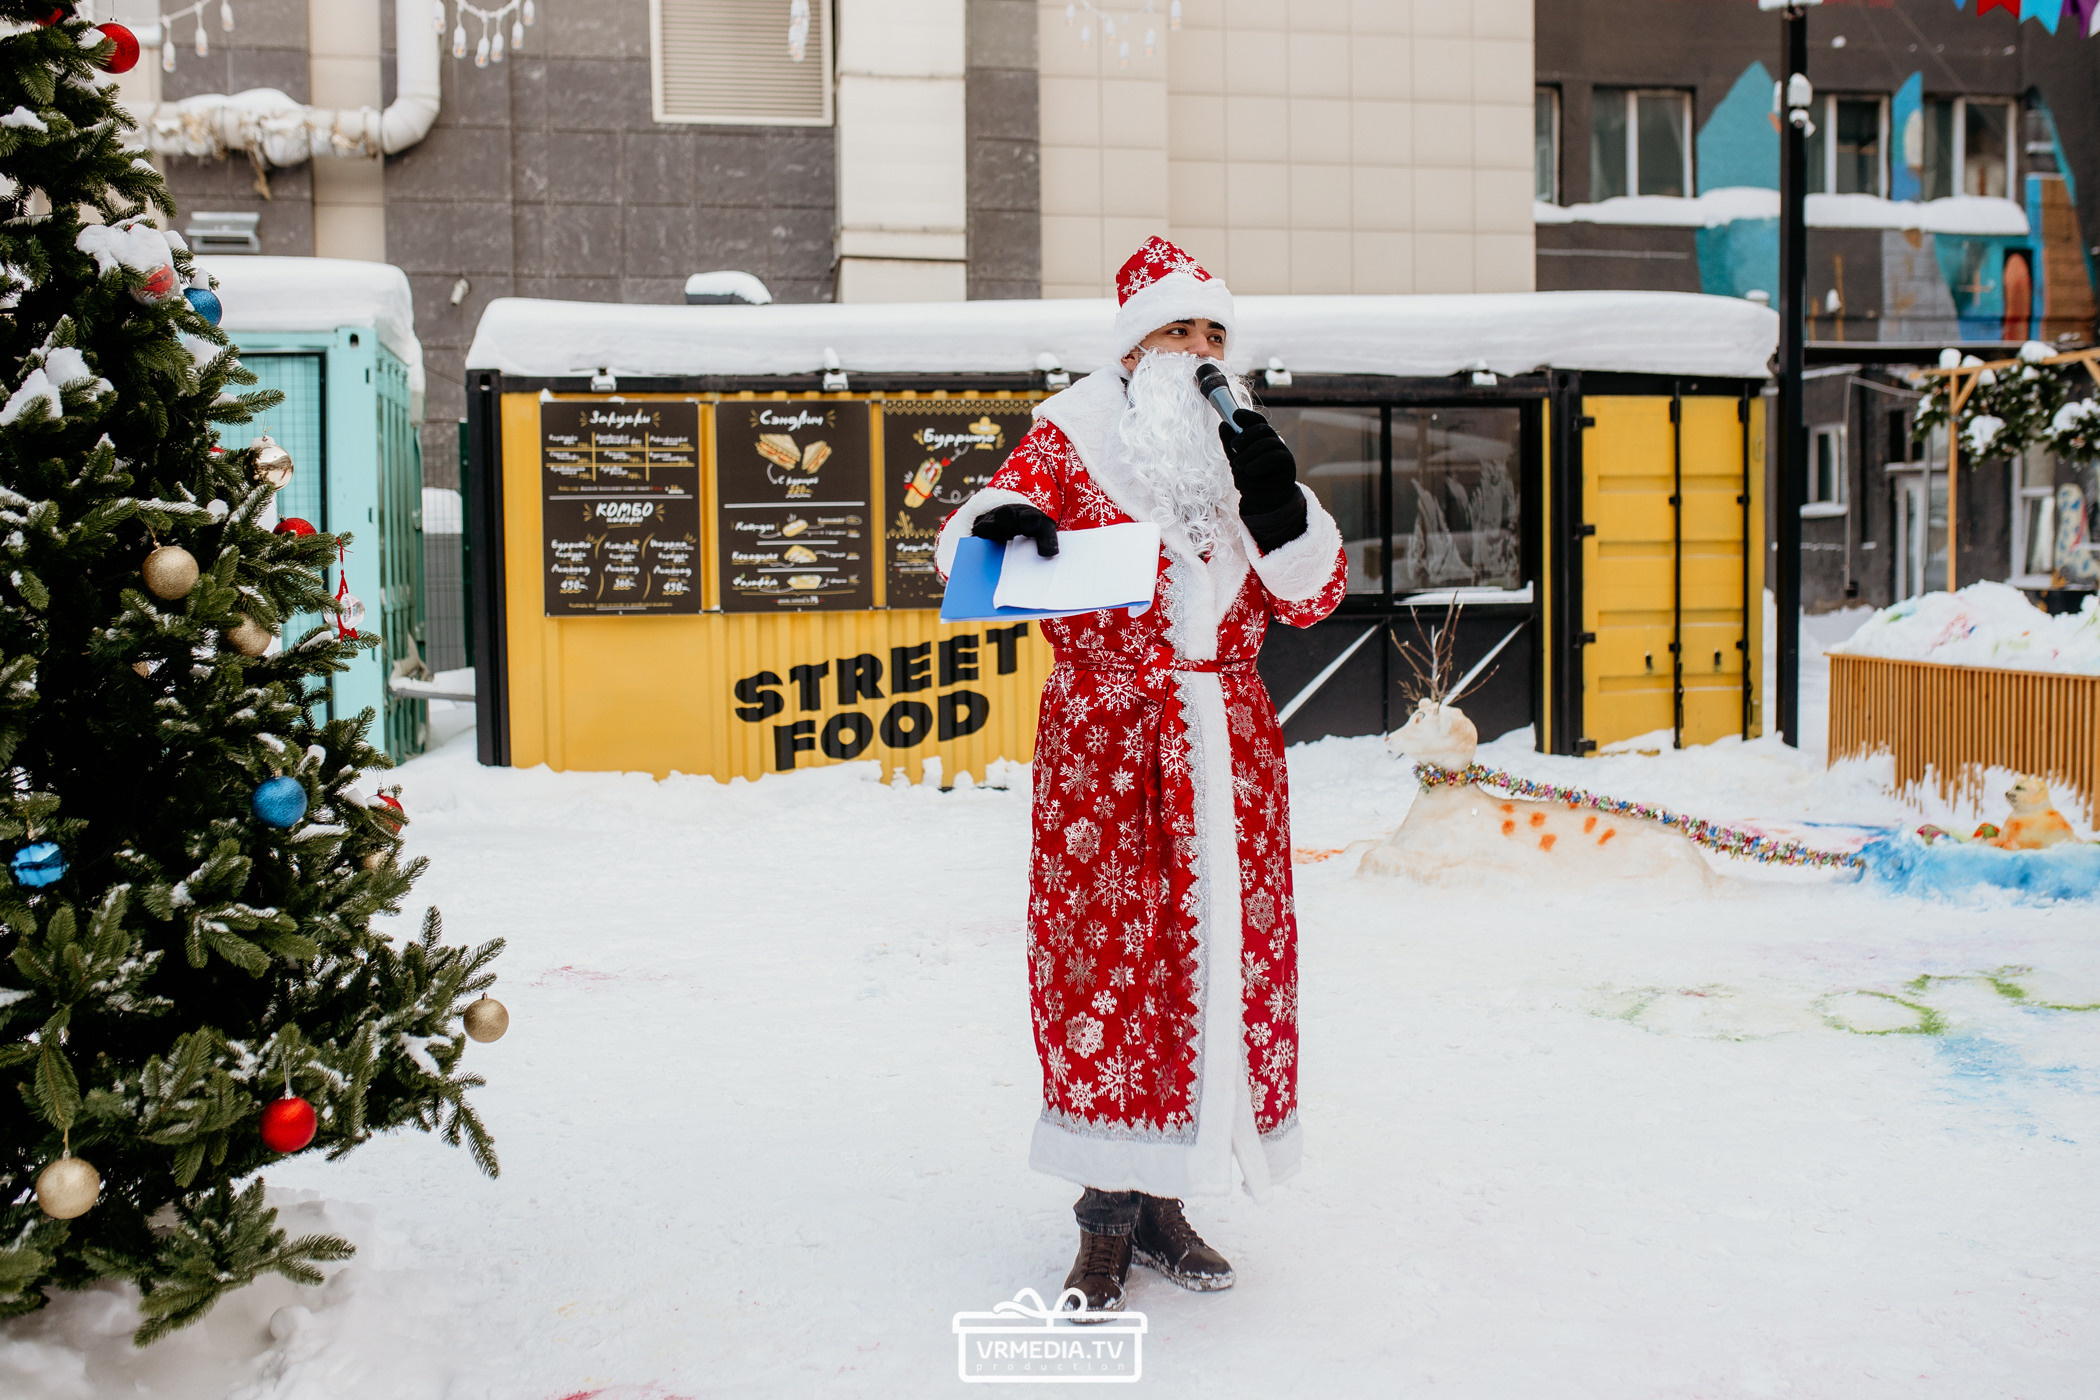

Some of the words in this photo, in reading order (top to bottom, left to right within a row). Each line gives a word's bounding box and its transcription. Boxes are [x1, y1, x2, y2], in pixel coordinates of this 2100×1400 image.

[589, 410, 651, 429] Закуски
[923, 428, 996, 450] Буррито
[596, 502, 654, 517] КОМБО
[734, 623, 1029, 723] STREET
[773, 690, 990, 771] FOOD
